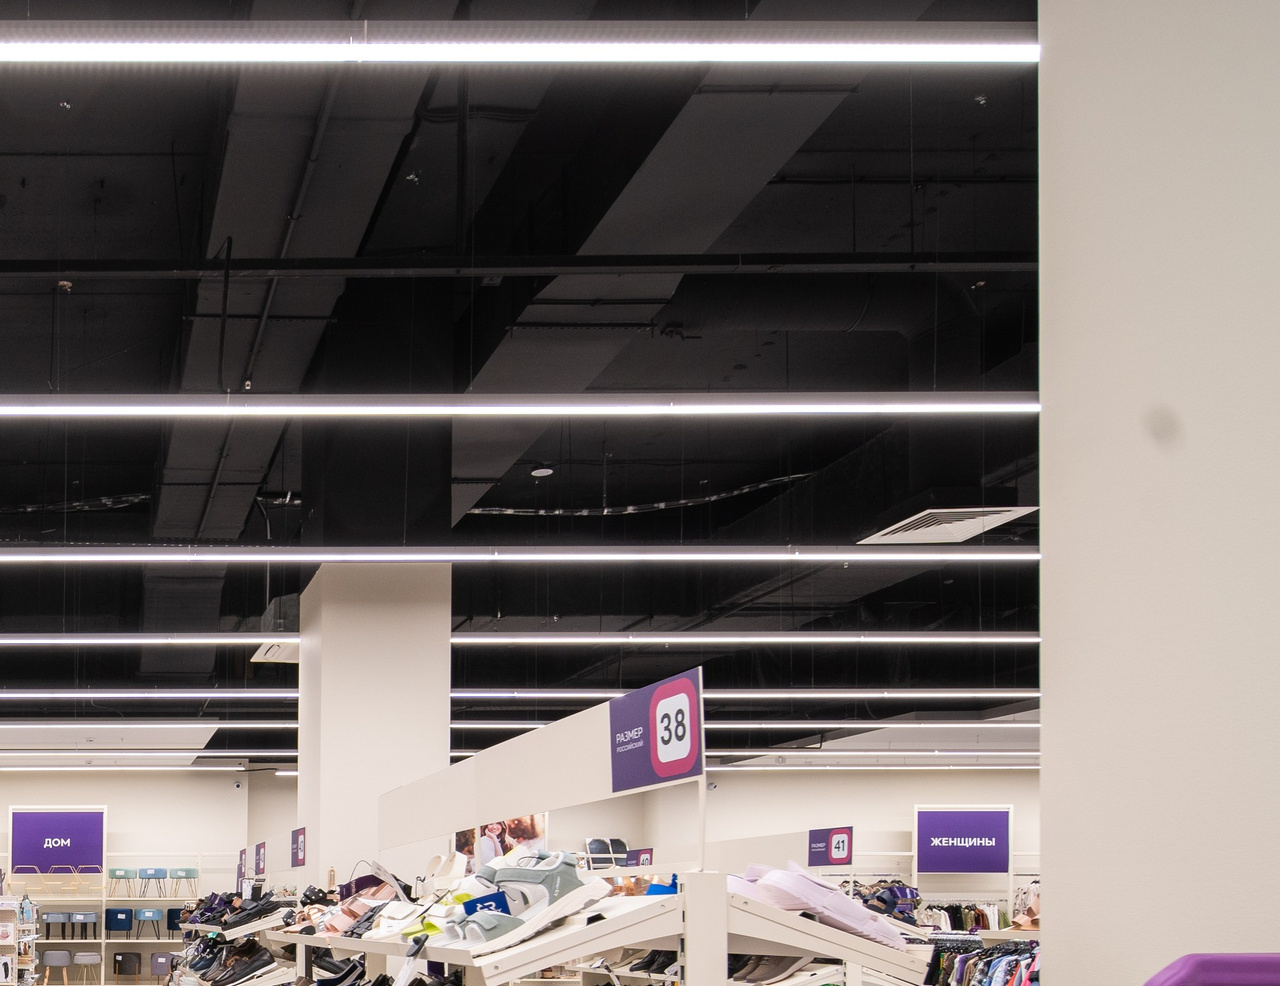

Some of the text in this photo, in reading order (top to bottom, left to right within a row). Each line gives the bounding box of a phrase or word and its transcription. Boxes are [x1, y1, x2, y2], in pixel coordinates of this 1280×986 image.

[660, 708, 686, 746] 38
[615, 726, 644, 744] РАЗМЕР
[43, 837, 71, 849] ДОМ
[833, 839, 845, 852] 41
[930, 837, 996, 848] ЖЕНЩИНЫ
